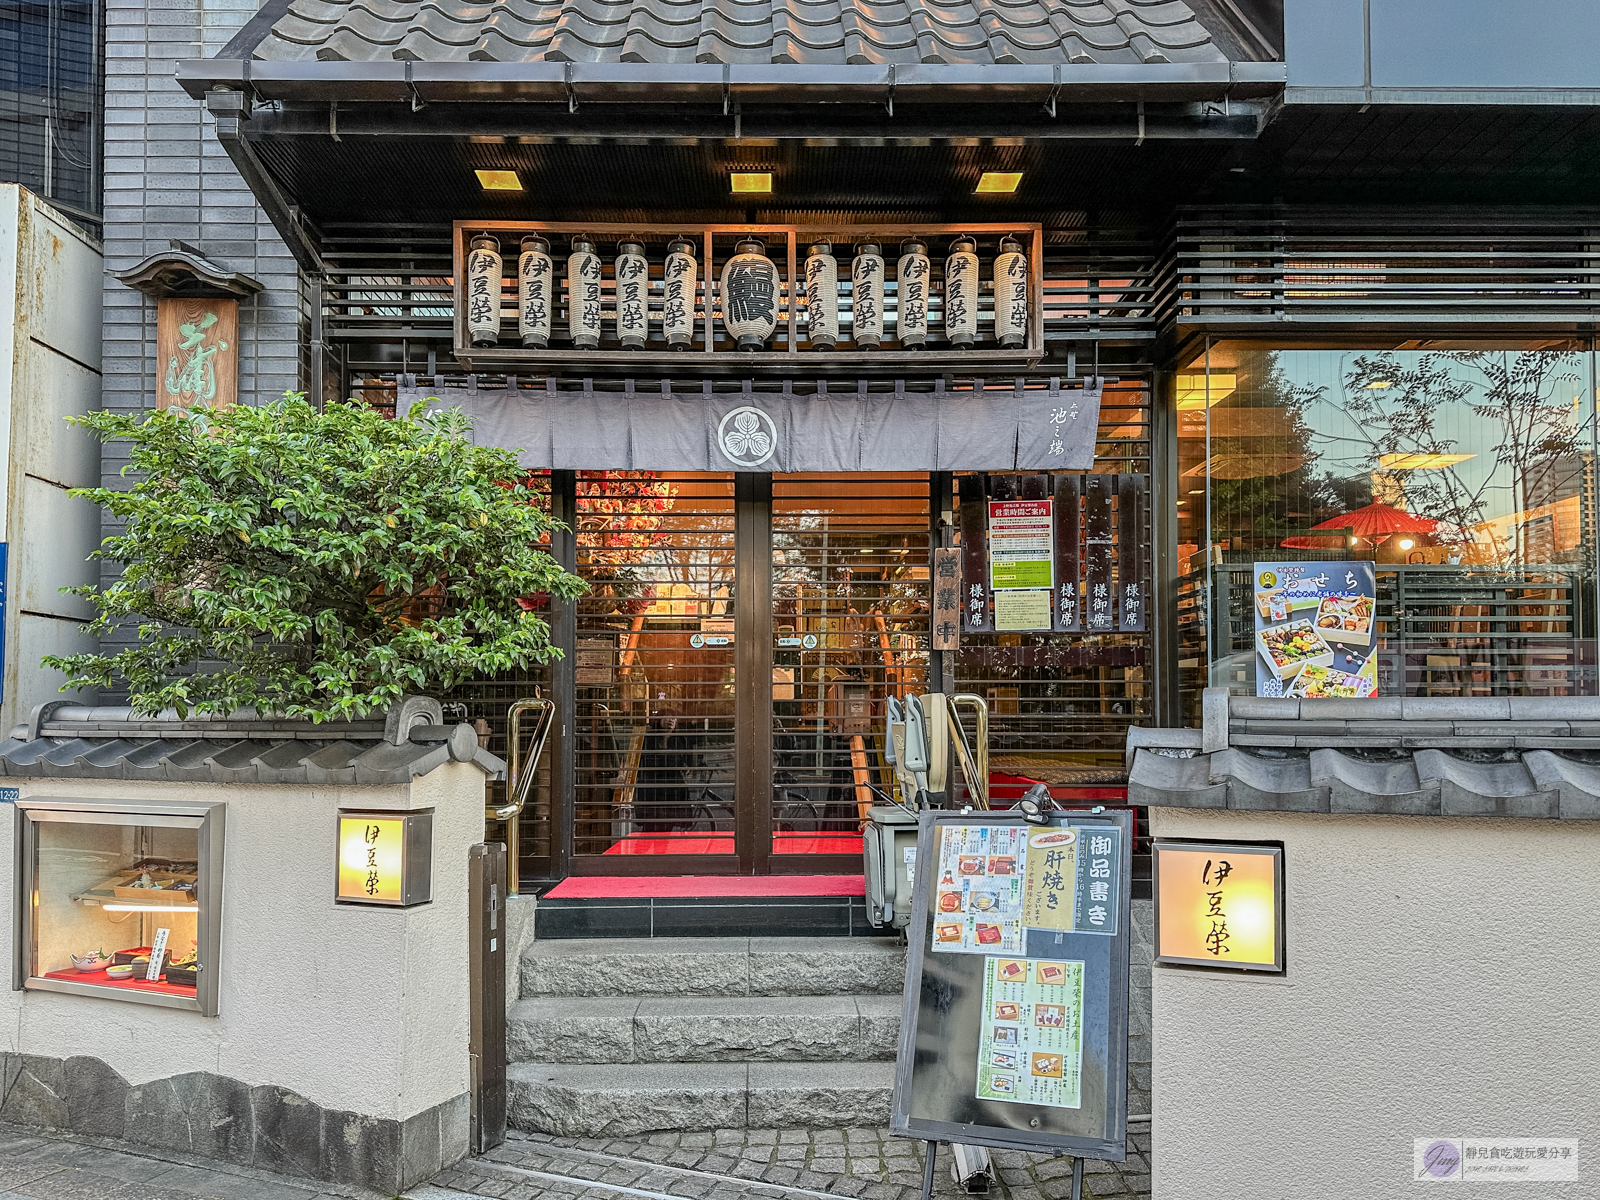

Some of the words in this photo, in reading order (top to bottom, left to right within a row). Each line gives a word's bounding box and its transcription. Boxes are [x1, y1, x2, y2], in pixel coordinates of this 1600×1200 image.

[1048, 407, 1067, 456] 池之端
[995, 508, 1046, 517] 営業時間ご案内
[937, 555, 958, 643] 営業中
[1282, 570, 1358, 590] おせち
[1041, 849, 1066, 910] 肝焼き
[1088, 835, 1112, 926] 御品書き
